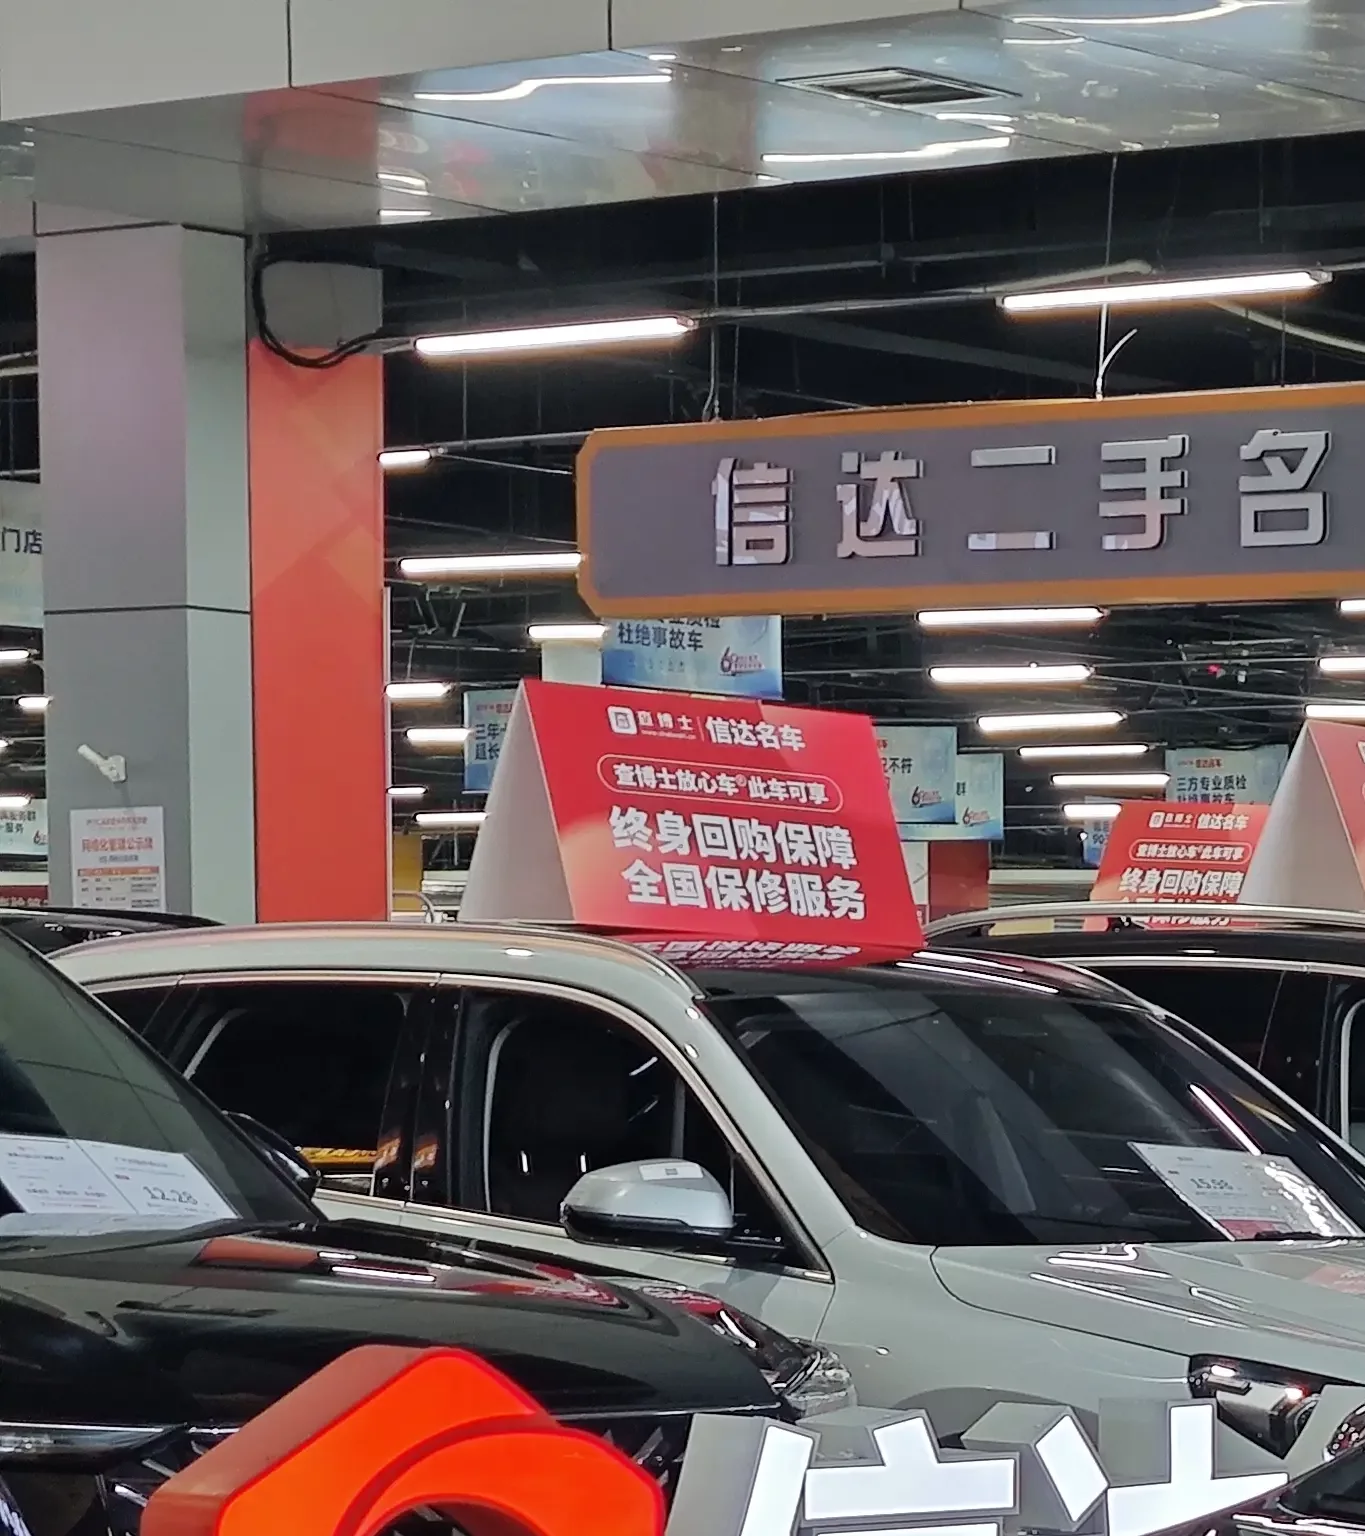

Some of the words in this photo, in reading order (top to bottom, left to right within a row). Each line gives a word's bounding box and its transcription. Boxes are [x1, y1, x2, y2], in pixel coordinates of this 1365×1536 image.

[616, 621, 704, 652] 杜绝事故车
[705, 716, 806, 751] 信达名车
[1176, 774, 1247, 791] 三方专业质检
[1196, 812, 1249, 831] 信达名车
[608, 805, 858, 870] 终身回购保障
[620, 858, 866, 920] 全国保修服务
[1118, 867, 1247, 898] 终身回购保障
